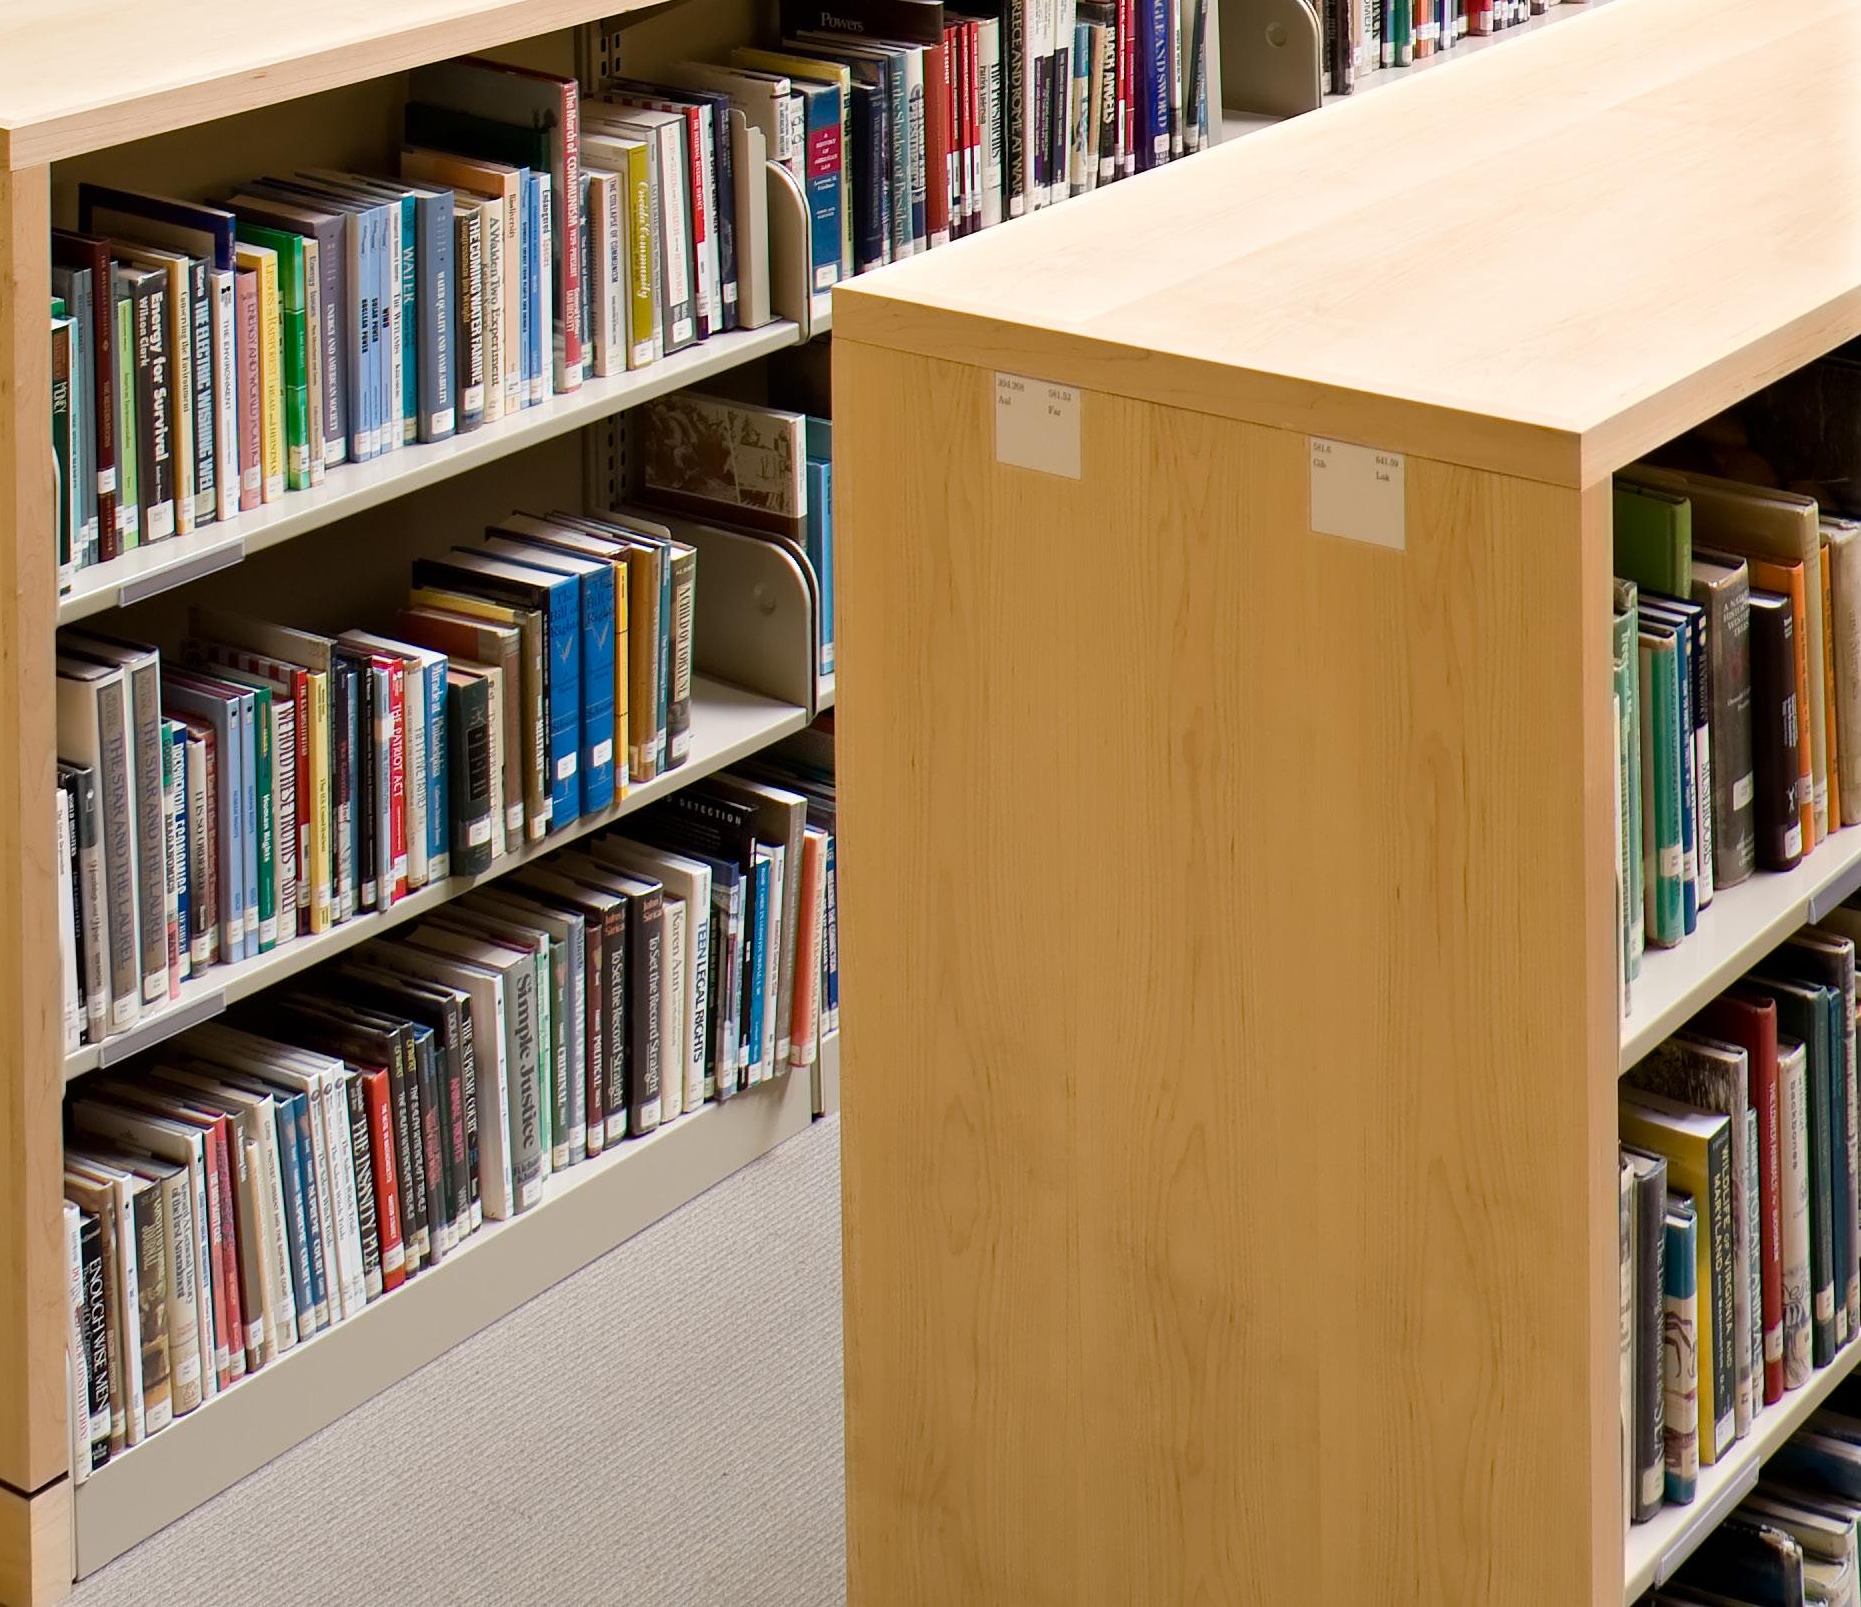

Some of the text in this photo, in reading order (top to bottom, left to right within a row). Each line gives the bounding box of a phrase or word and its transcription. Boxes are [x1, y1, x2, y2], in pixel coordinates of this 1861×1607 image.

[820, 12, 864, 32] Powers
[1012, 52, 1023, 84] AND
[1103, 25, 1115, 124] BLACK ANGELS
[1154, 39, 1167, 72] AND
[565, 90, 576, 111] The
[565, 110, 576, 142] March
[1012, 85, 1023, 136] ROME
[1155, 73, 1168, 128] SWORD
[1012, 137, 1023, 158] AT
[566, 155, 578, 227] COMMUNISM
[1012, 158, 1024, 197] WAR
[402, 246, 416, 305] WATER
[489, 226, 501, 279] Walden
[468, 216, 483, 386] THE COMING WATER FAMINE
[490, 281, 501, 306] Two
[138, 296, 150, 368] Wilson Clark
[488, 308, 501, 387] Experiment
[149, 291, 169, 462] Energy for Survival
[222, 318, 232, 411] THE ENVIRONMENT
[54, 381, 68, 415] MONEY
[196, 298, 215, 492] THE ELECTRIC WISHING WEL
[277, 705, 294, 729] WE
[278, 730, 295, 767] HOLD
[392, 703, 404, 797] THE PATRIOT ACT
[279, 768, 295, 810] THESE
[679, 798, 742, 826] DETECTION
[109, 735, 132, 966] THE STAR AND THE LAUREL
[144, 719, 164, 948] THE STAR AND THE LAUREL
[261, 793, 272, 863] Human Rights
[280, 812, 296, 865] TRUTHS
[612, 963, 622, 983] Set
[649, 951, 660, 970] Set
[672, 910, 684, 992] Karen Ann
[612, 984, 623, 999] the
[648, 971, 660, 987] the
[693, 921, 708, 1064] TEEN LEGAL RIGHTS
[448, 1011, 458, 1049] DOLAN
[612, 1000, 623, 1054] Record
[648, 987, 660, 1041] Record
[515, 972, 538, 1150] Simple Justice
[593, 1034, 603, 1087] POLITICAL
[609, 1056, 623, 1107] Straight
[645, 1042, 660, 1095] Straight
[1719, 1144, 1733, 1230] WILDLIFE
[1711, 1173, 1724, 1272] MARYLAND
[1721, 1252, 1734, 1334] VIRGINIA
[88, 1257, 109, 1411] ENOUGH WISE MEN
[1724, 1338, 1735, 1370] AND
